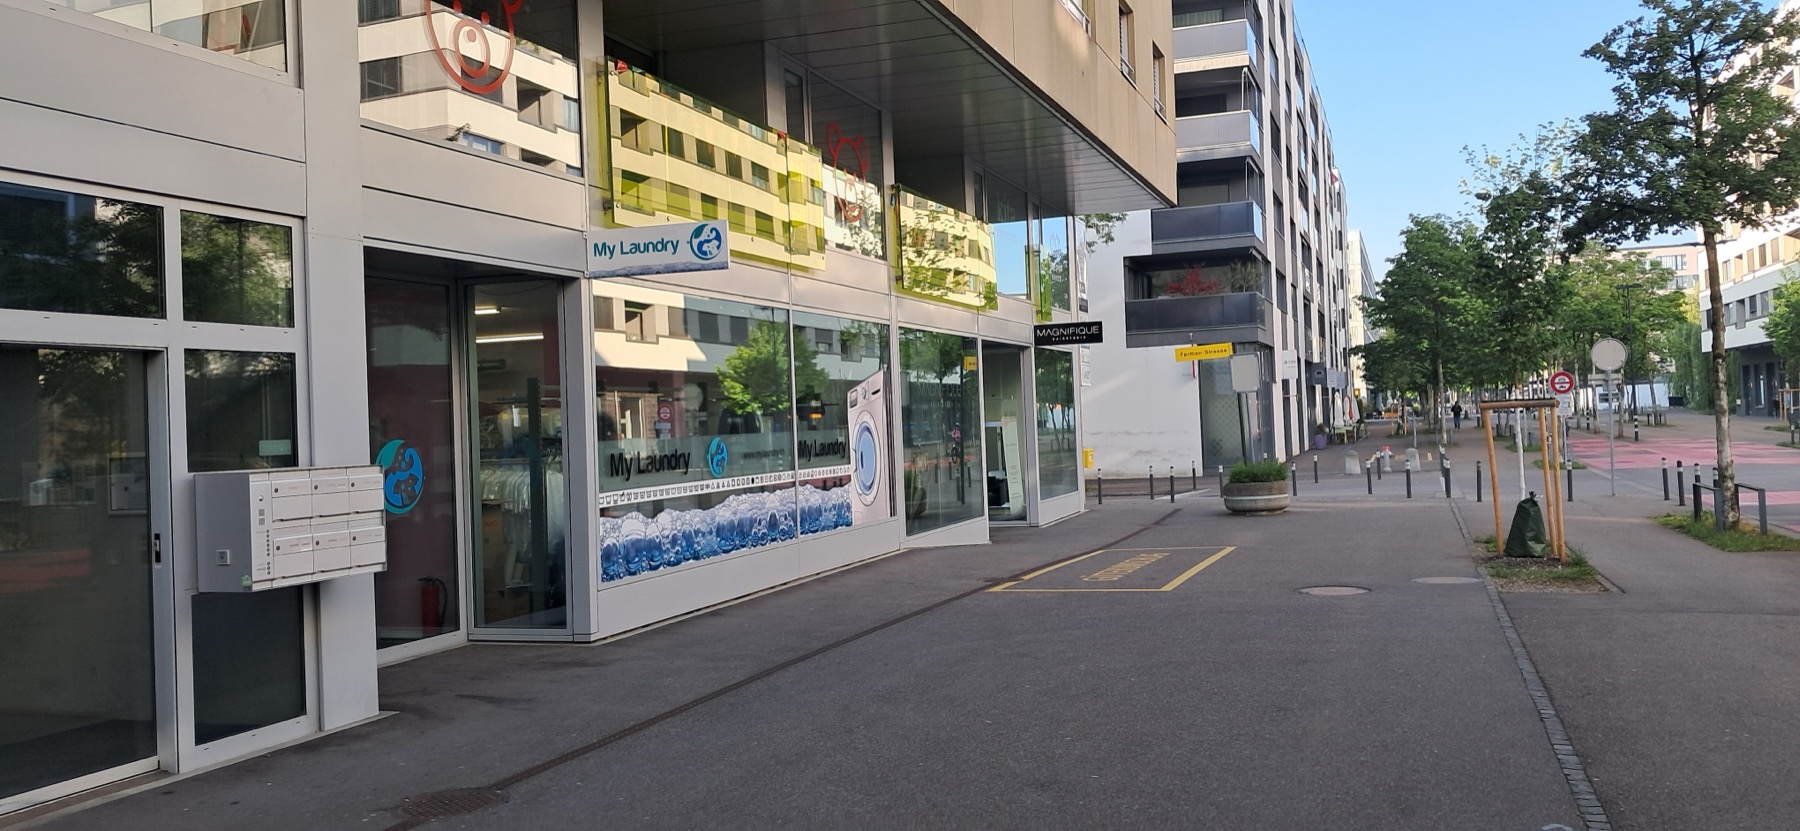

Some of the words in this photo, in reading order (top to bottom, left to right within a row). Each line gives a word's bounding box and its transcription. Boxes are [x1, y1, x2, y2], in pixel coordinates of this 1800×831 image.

[593, 242, 616, 260] My
[620, 237, 680, 255] Laundry
[1036, 325, 1100, 337] MAGNIFIQUE
[798, 440, 812, 462] My
[815, 437, 847, 459] Laundry
[610, 452, 633, 482] My
[637, 448, 691, 475] Laundry
